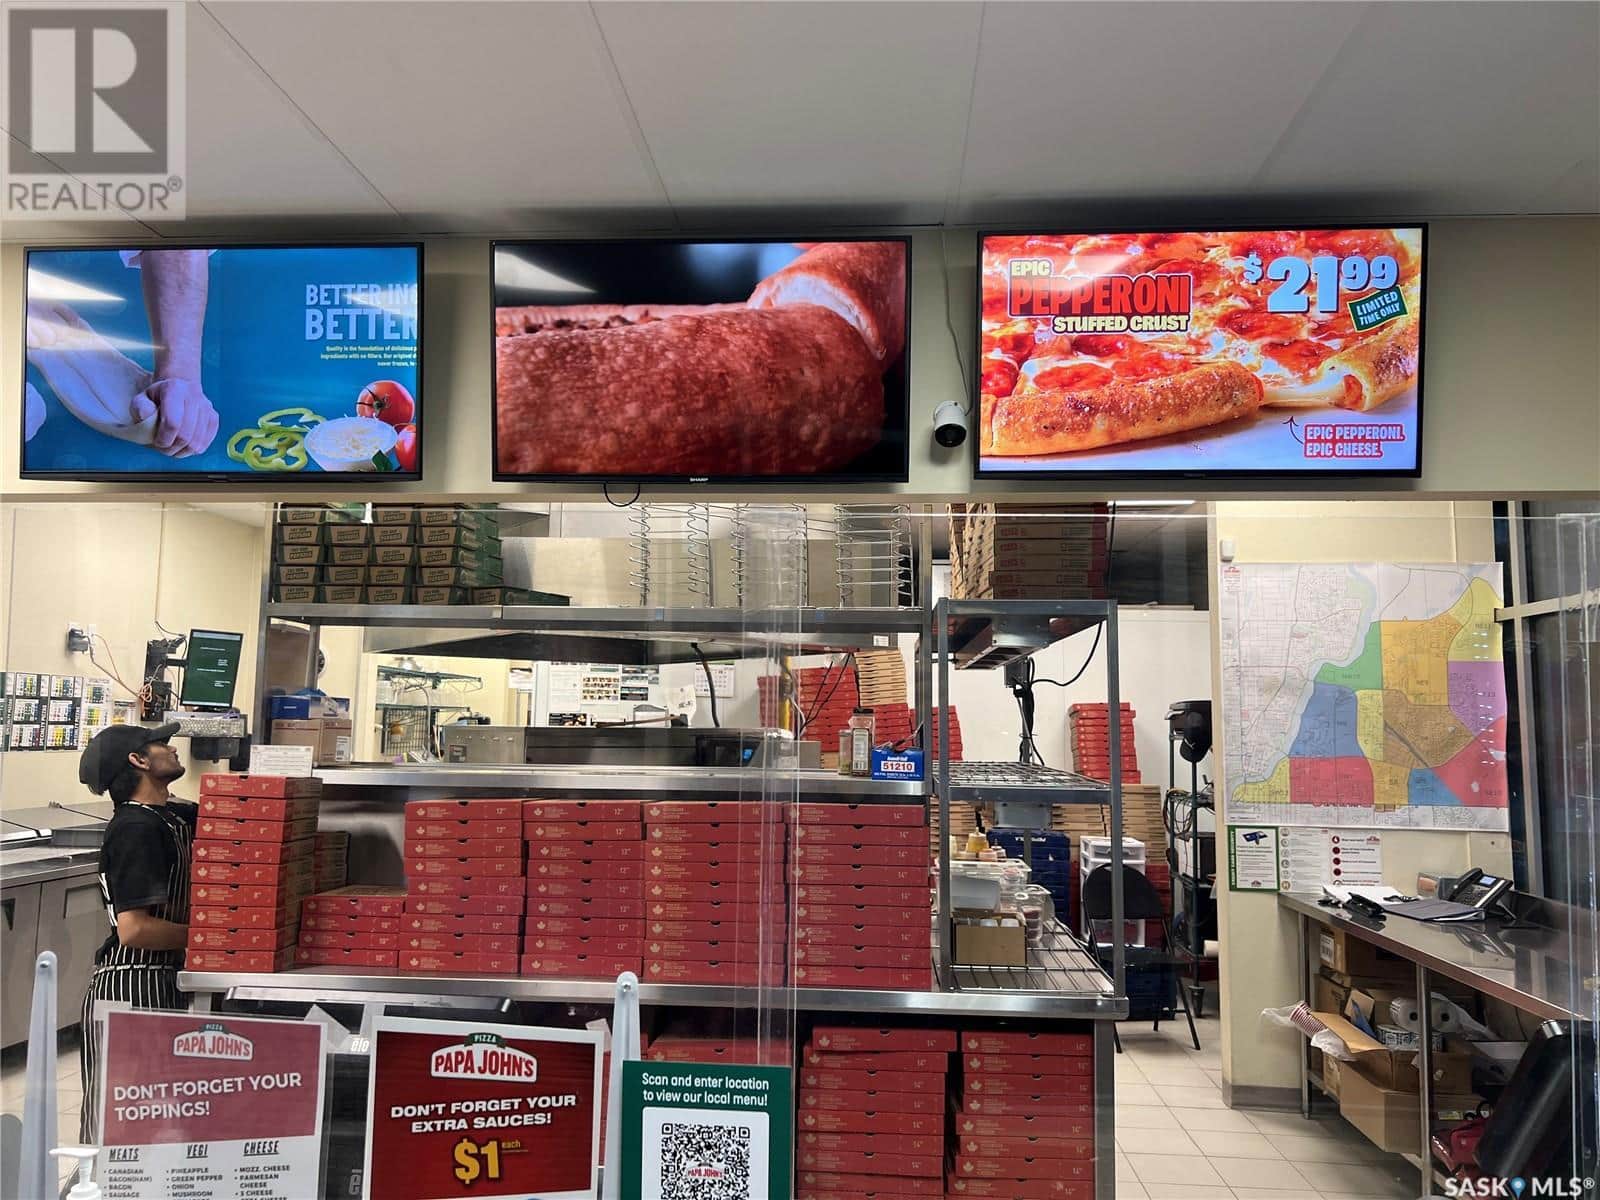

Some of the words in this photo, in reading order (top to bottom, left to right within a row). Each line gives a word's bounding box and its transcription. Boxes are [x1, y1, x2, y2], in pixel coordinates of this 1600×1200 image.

[1011, 261, 1050, 276] EPIC
[306, 284, 381, 305] BETTER
[1012, 277, 1189, 314] PEPPERONI
[1356, 291, 1399, 316] LIMITED
[1054, 316, 1128, 332] STUFFED
[1130, 315, 1189, 331] CRUST
[1359, 313, 1381, 326] TIME
[1380, 305, 1400, 320] ONLY
[1306, 426, 1333, 440] EPIC
[1306, 443, 1333, 456] EPIC
[883, 762, 913, 771] 51210
[176, 1036, 207, 1053] PAPA
[208, 1035, 251, 1057] JOHN'S
[474, 1034, 497, 1043] PIZZA
[434, 1050, 475, 1073] PAPA
[478, 1052, 533, 1077] JOHN'S
[114, 1083, 168, 1101] DON'T
[173, 1077, 245, 1097] FORGET
[249, 1072, 302, 1090] YOUR
[642, 1072, 668, 1086] Scan
[671, 1074, 692, 1088] and
[694, 1077, 722, 1089] enter
[725, 1076, 769, 1091] location
[391, 1104, 445, 1118] DON'T
[451, 1098, 522, 1114] FORGET
[526, 1095, 576, 1108] YOUR
[643, 1090, 654, 1101] to
[656, 1090, 680, 1102] view
[683, 1093, 701, 1103] our
[704, 1091, 730, 1105] local
[733, 1095, 768, 1106] menu!
[115, 1101, 210, 1121] TOPPINGS!
[412, 1119, 468, 1133] EXTRA
[473, 1113, 551, 1129] SAUCES!
[109, 1148, 139, 1161] MEATS
[187, 1144, 208, 1157] VEGI
[244, 1140, 280, 1154] CHEESE
[454, 1138, 500, 1184] $1
[502, 1140, 521, 1149] each
[171, 1167, 208, 1175] PINEAPPLE
